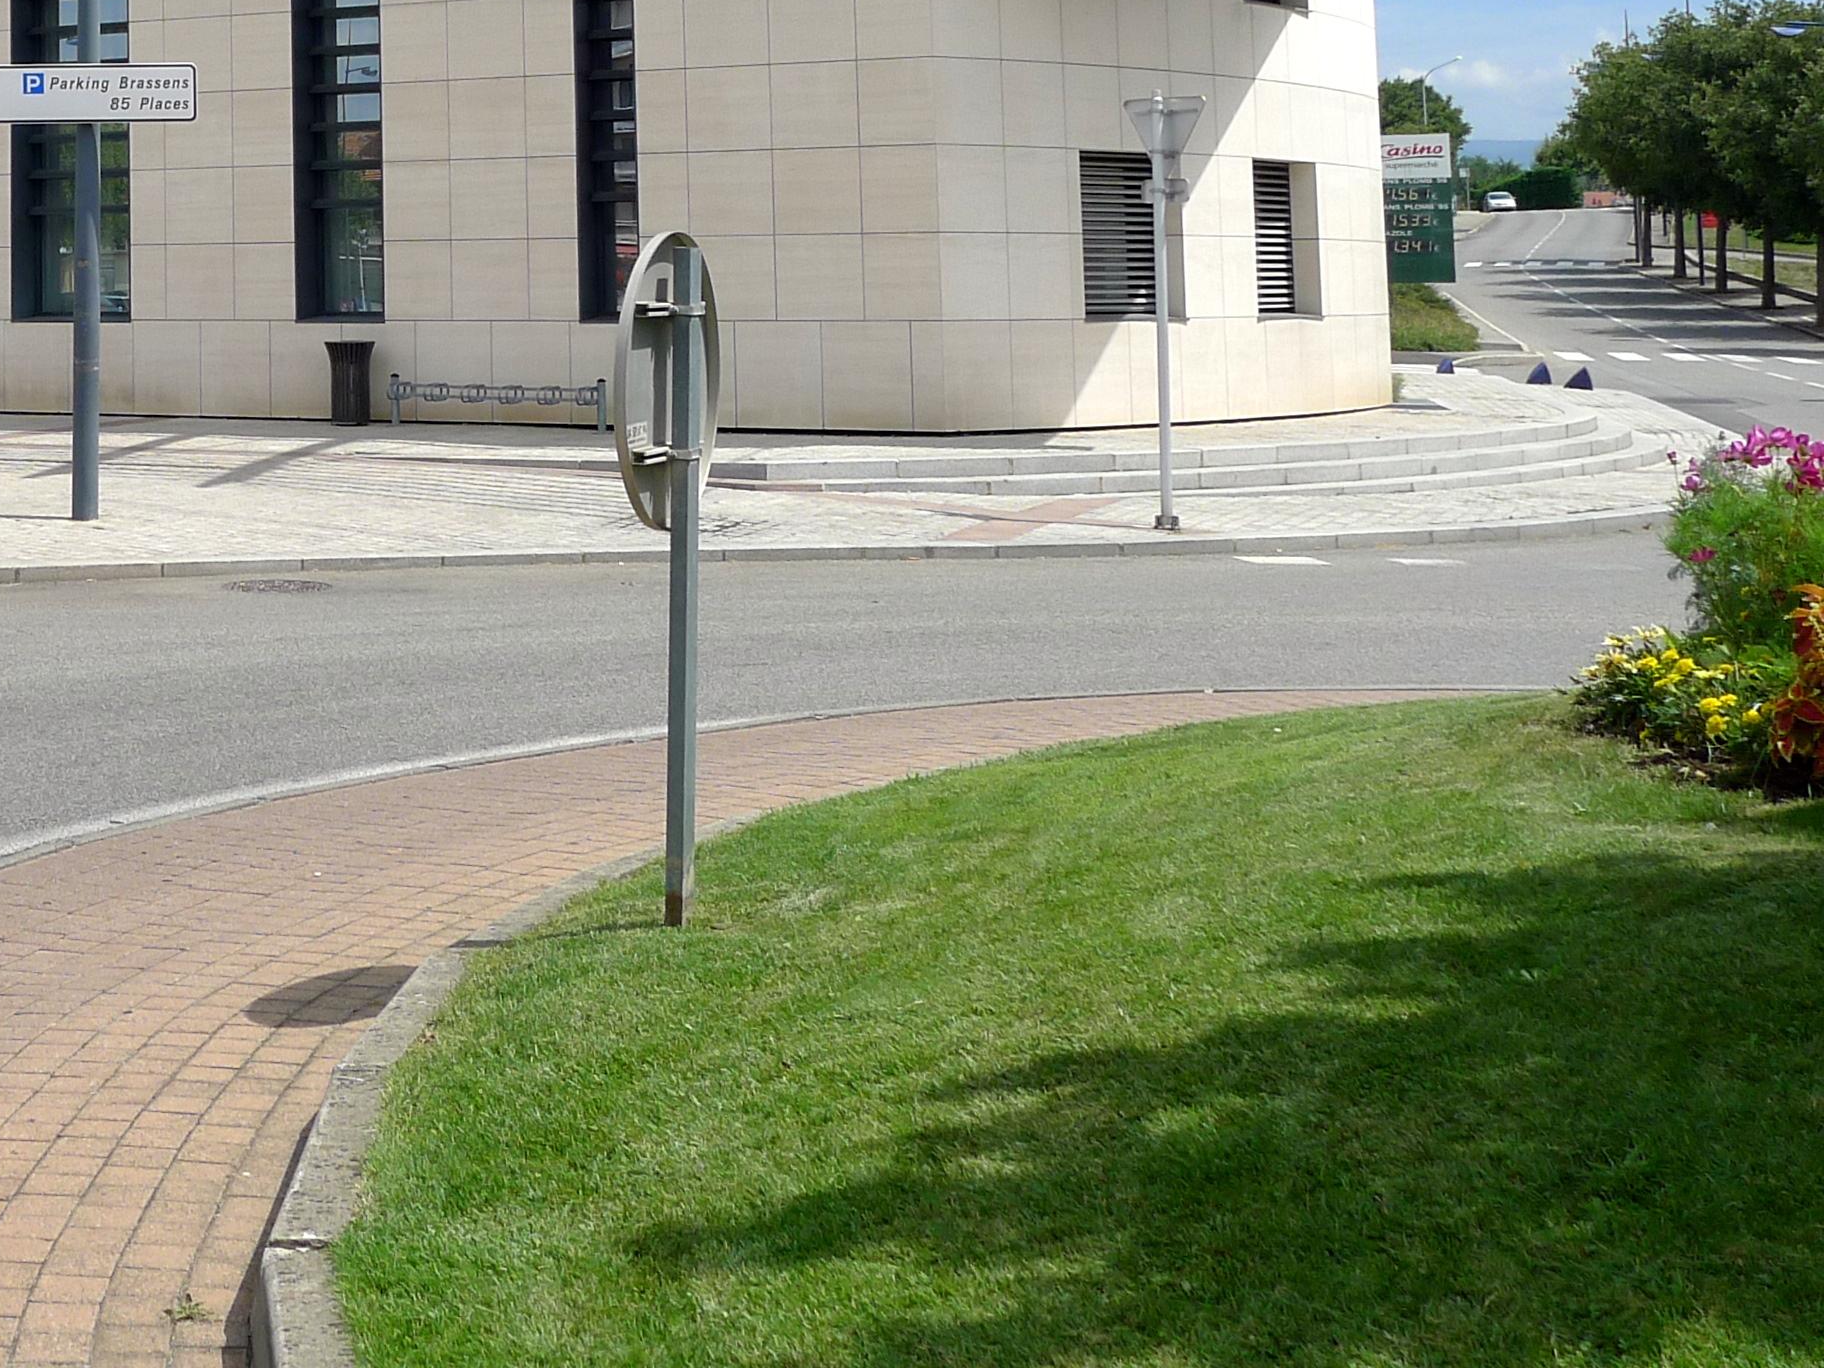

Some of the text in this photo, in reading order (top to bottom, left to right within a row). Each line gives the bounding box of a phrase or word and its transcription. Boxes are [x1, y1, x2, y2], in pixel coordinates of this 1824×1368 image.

[26, 75, 190, 93] P Parking Brassens
[109, 96, 190, 110] 85 Places
